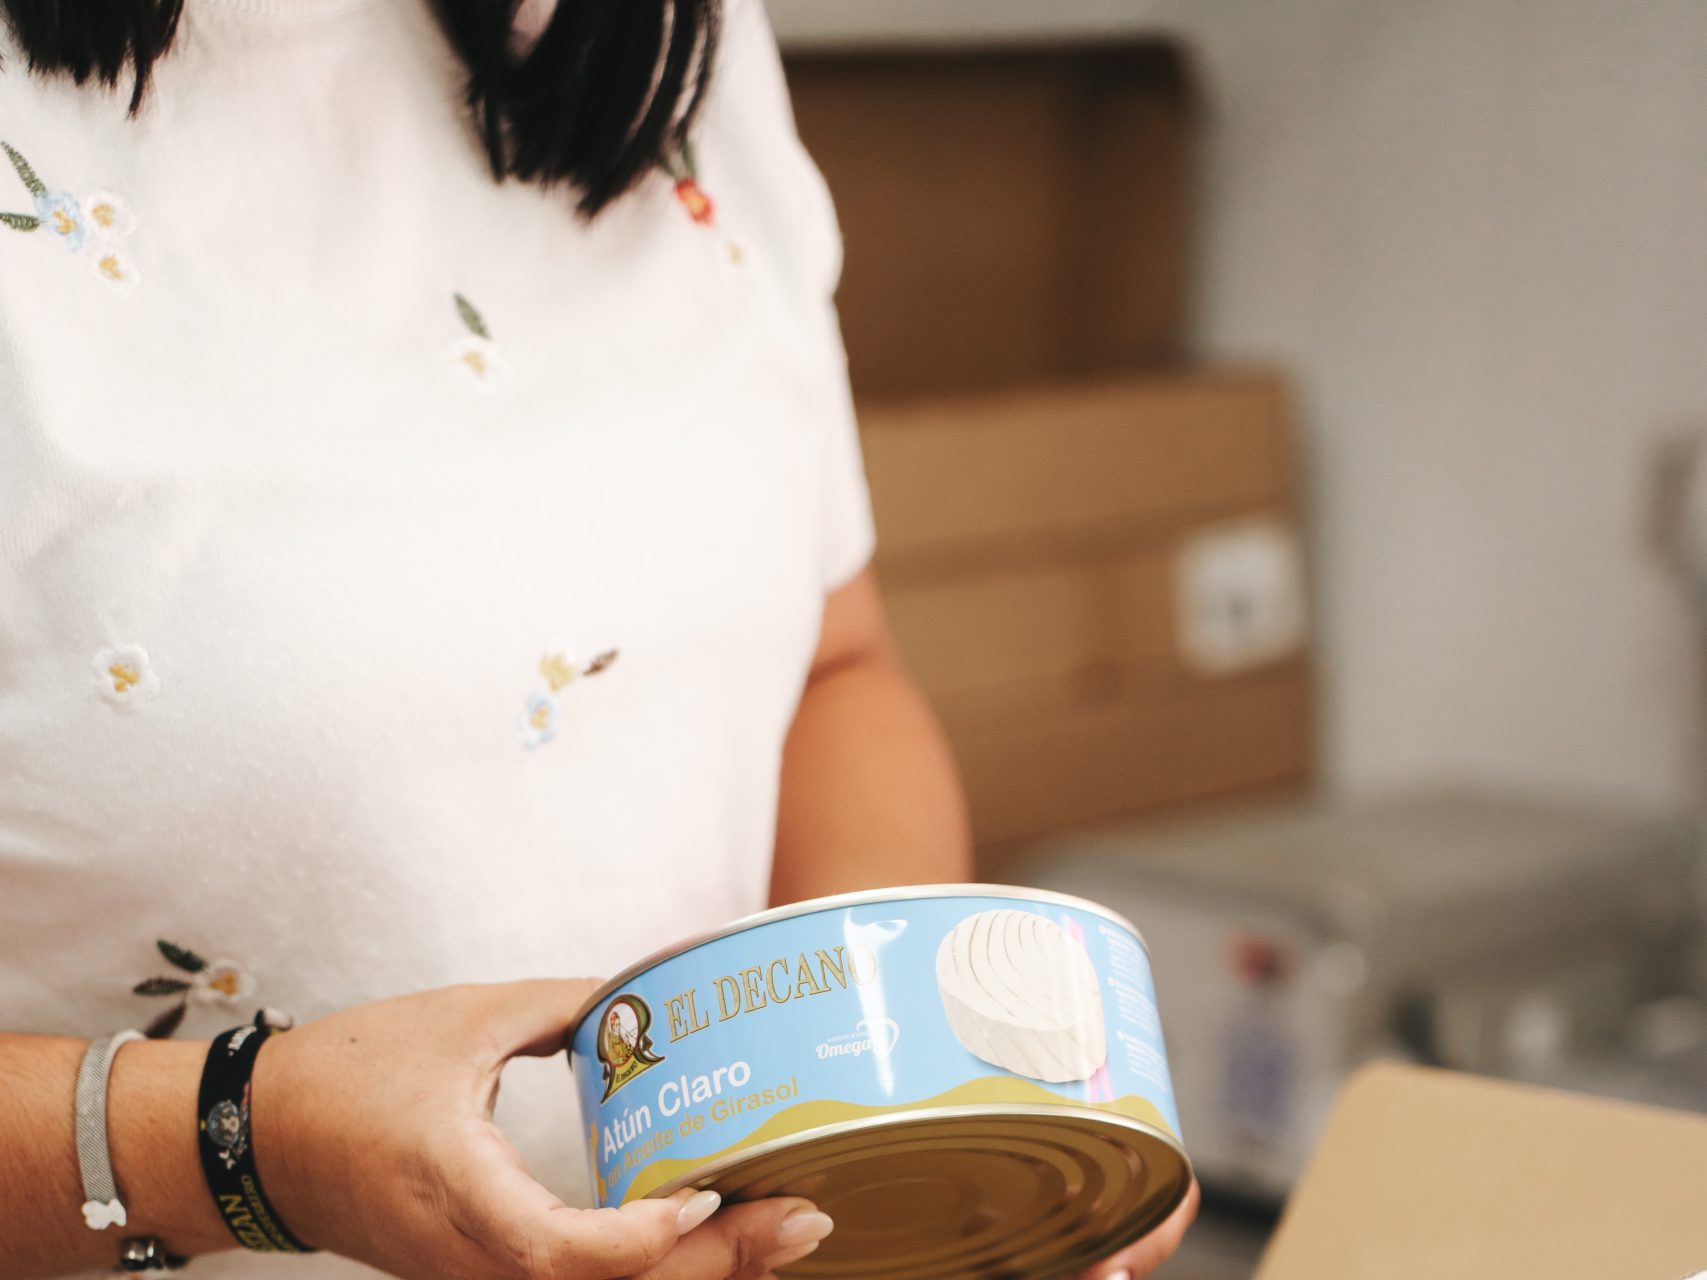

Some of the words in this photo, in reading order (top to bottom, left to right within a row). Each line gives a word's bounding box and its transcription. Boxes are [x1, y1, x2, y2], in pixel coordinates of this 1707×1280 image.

[663, 988, 710, 1043] EL
[713, 944, 877, 1022] DECANO
[815, 1038, 872, 1059] Omega
[602, 1104, 652, 1163] Atún
[658, 1061, 751, 1117] Claro
[624, 1127, 673, 1171] Aceite
[678, 1110, 705, 1137] de
[710, 1076, 799, 1122] Girasol
